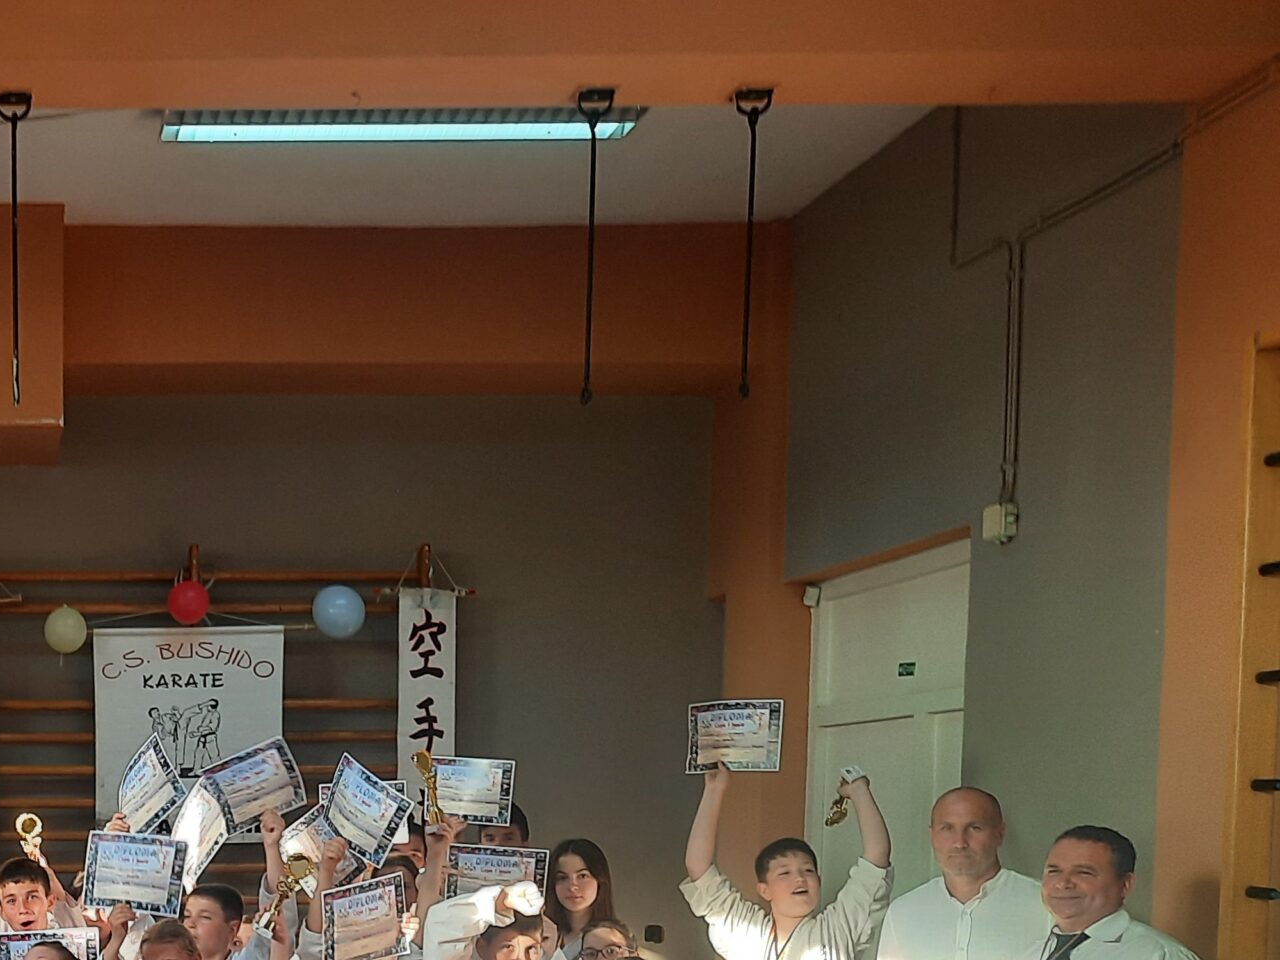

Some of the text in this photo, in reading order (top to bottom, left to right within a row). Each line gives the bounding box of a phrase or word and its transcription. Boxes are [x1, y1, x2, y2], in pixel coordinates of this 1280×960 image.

[156, 641, 275, 678] BUSHIDO
[142, 672, 225, 689] KARATE
[408, 608, 447, 807] 空手
